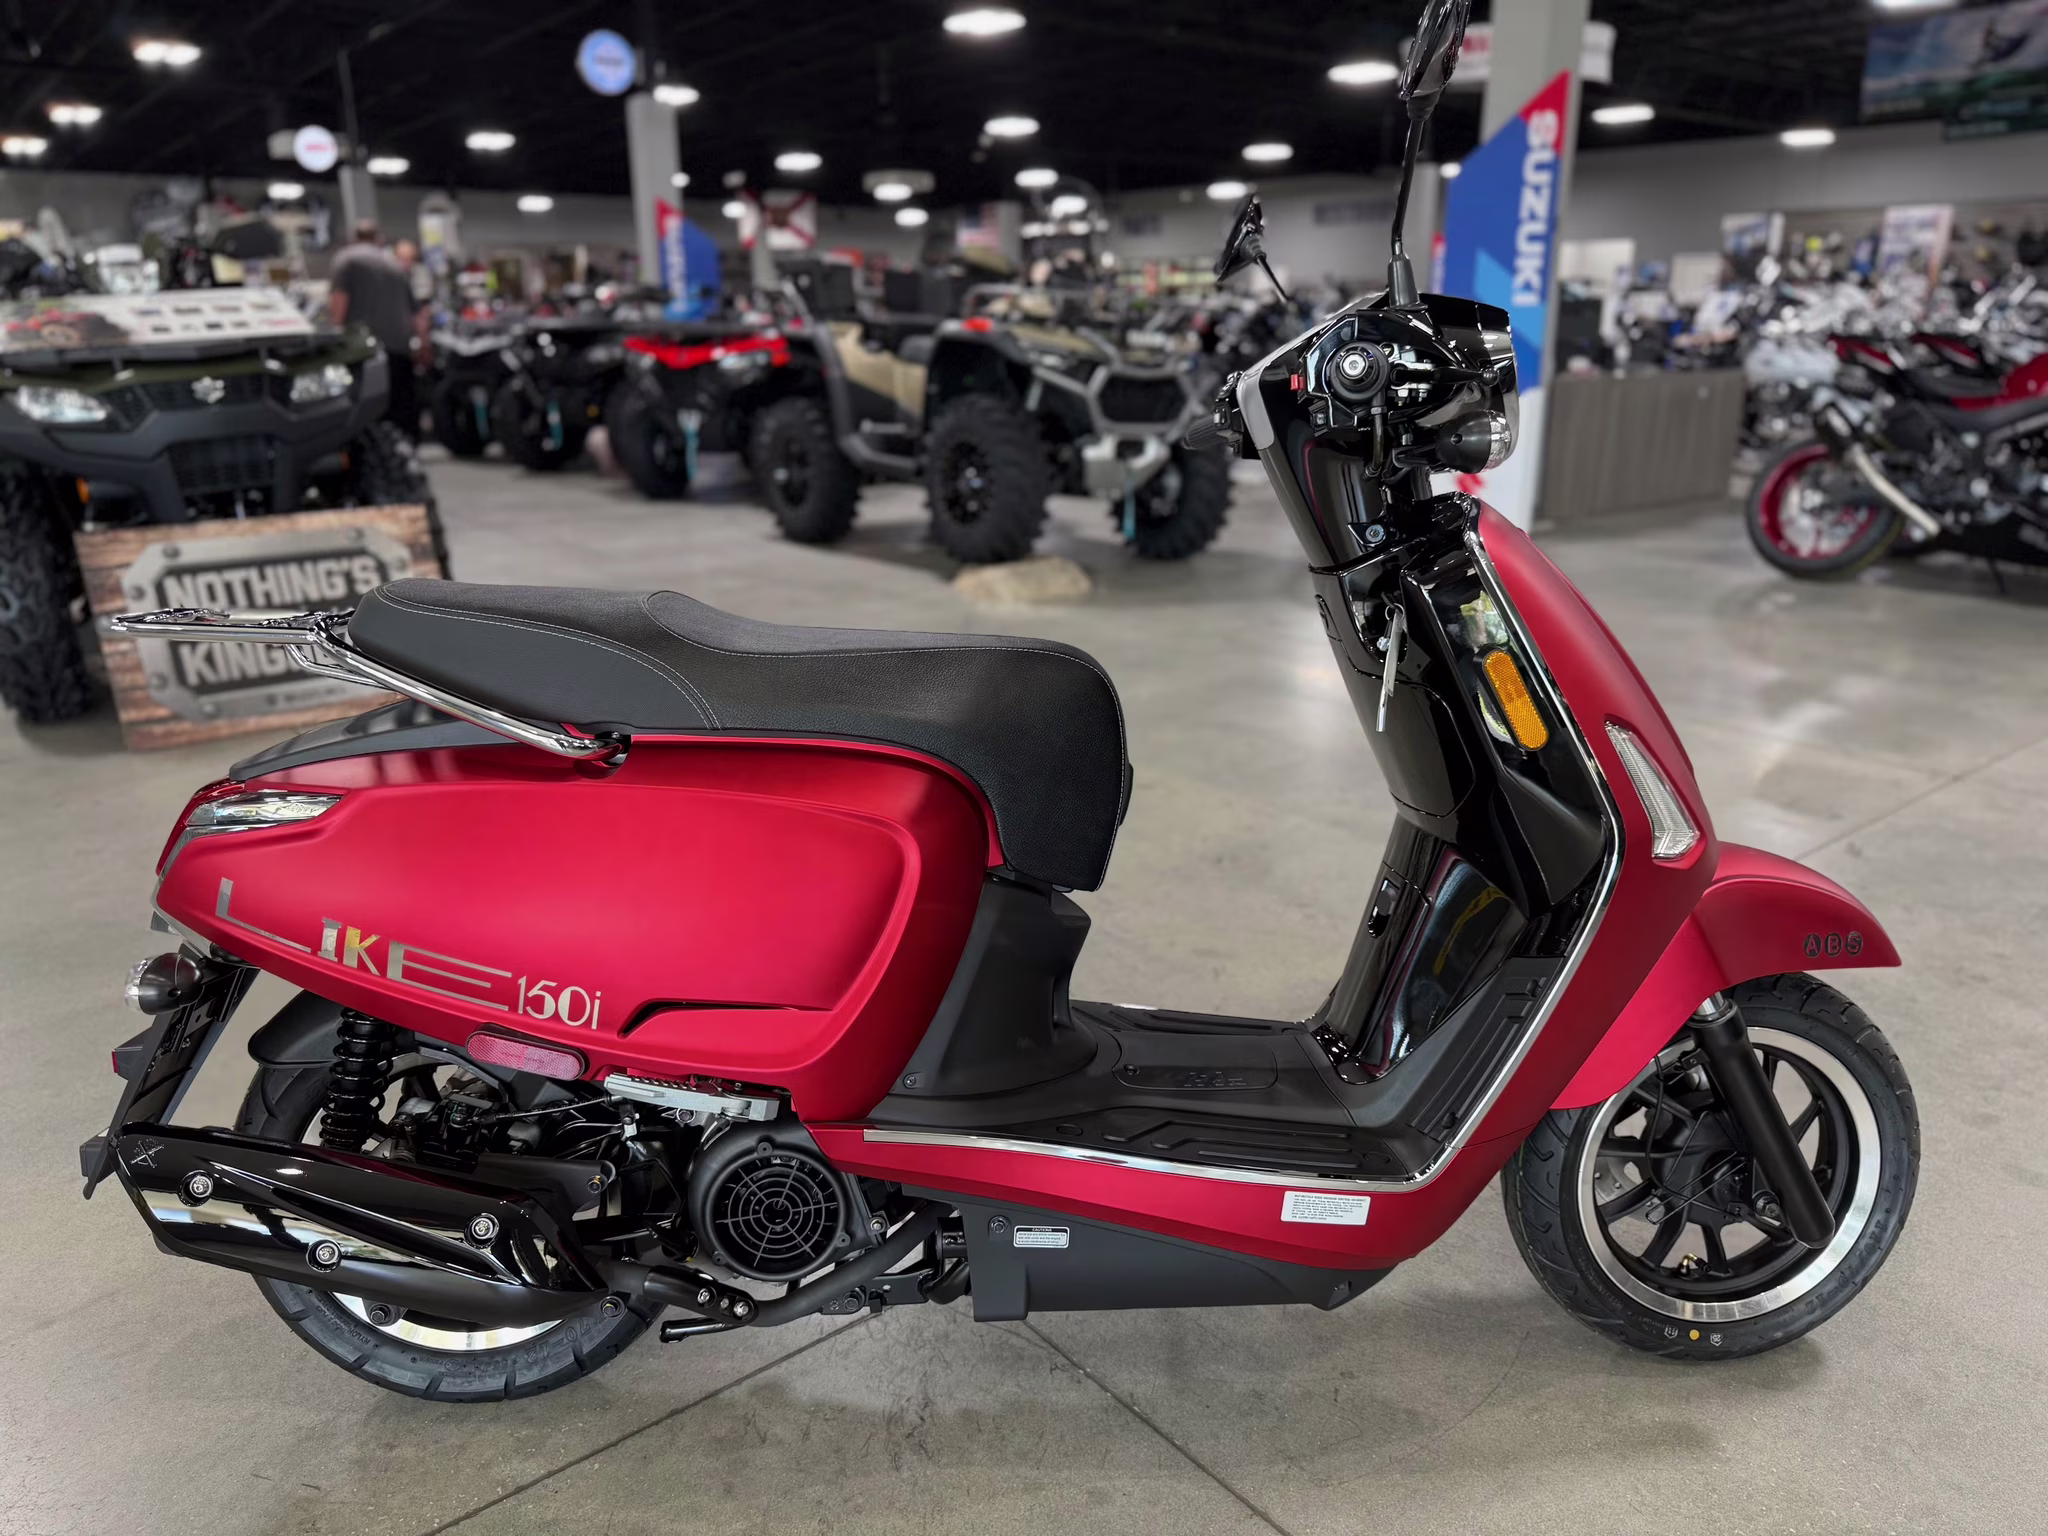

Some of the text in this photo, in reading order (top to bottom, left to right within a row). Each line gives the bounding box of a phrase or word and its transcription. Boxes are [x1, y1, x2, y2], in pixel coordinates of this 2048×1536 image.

[1511, 107, 1561, 308] SUZUKI
[162, 555, 382, 611] NOTHING'S
[215, 876, 603, 1031] LIKE 150i
[1803, 930, 1864, 959] ABS
